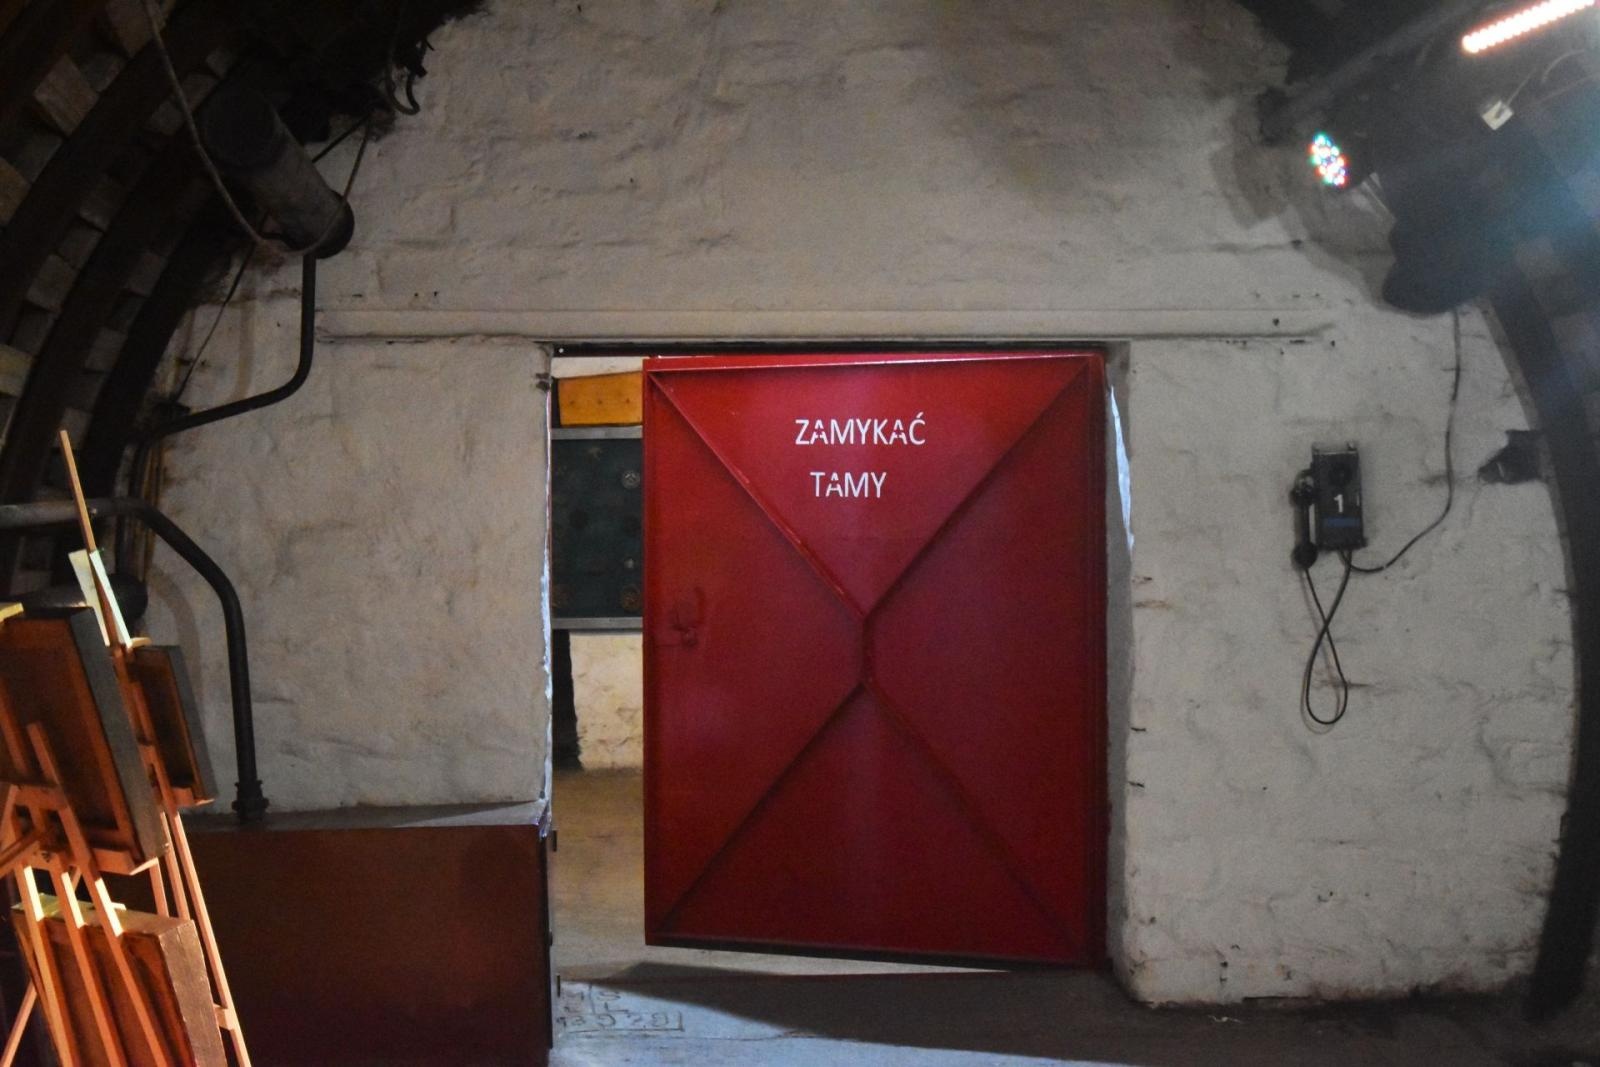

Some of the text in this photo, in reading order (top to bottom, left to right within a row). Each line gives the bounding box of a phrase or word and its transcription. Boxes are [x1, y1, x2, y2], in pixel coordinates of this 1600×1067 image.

[795, 411, 926, 445] ZAMYKAĆ
[810, 472, 887, 498] TAMY
[1333, 493, 1343, 513] 1
